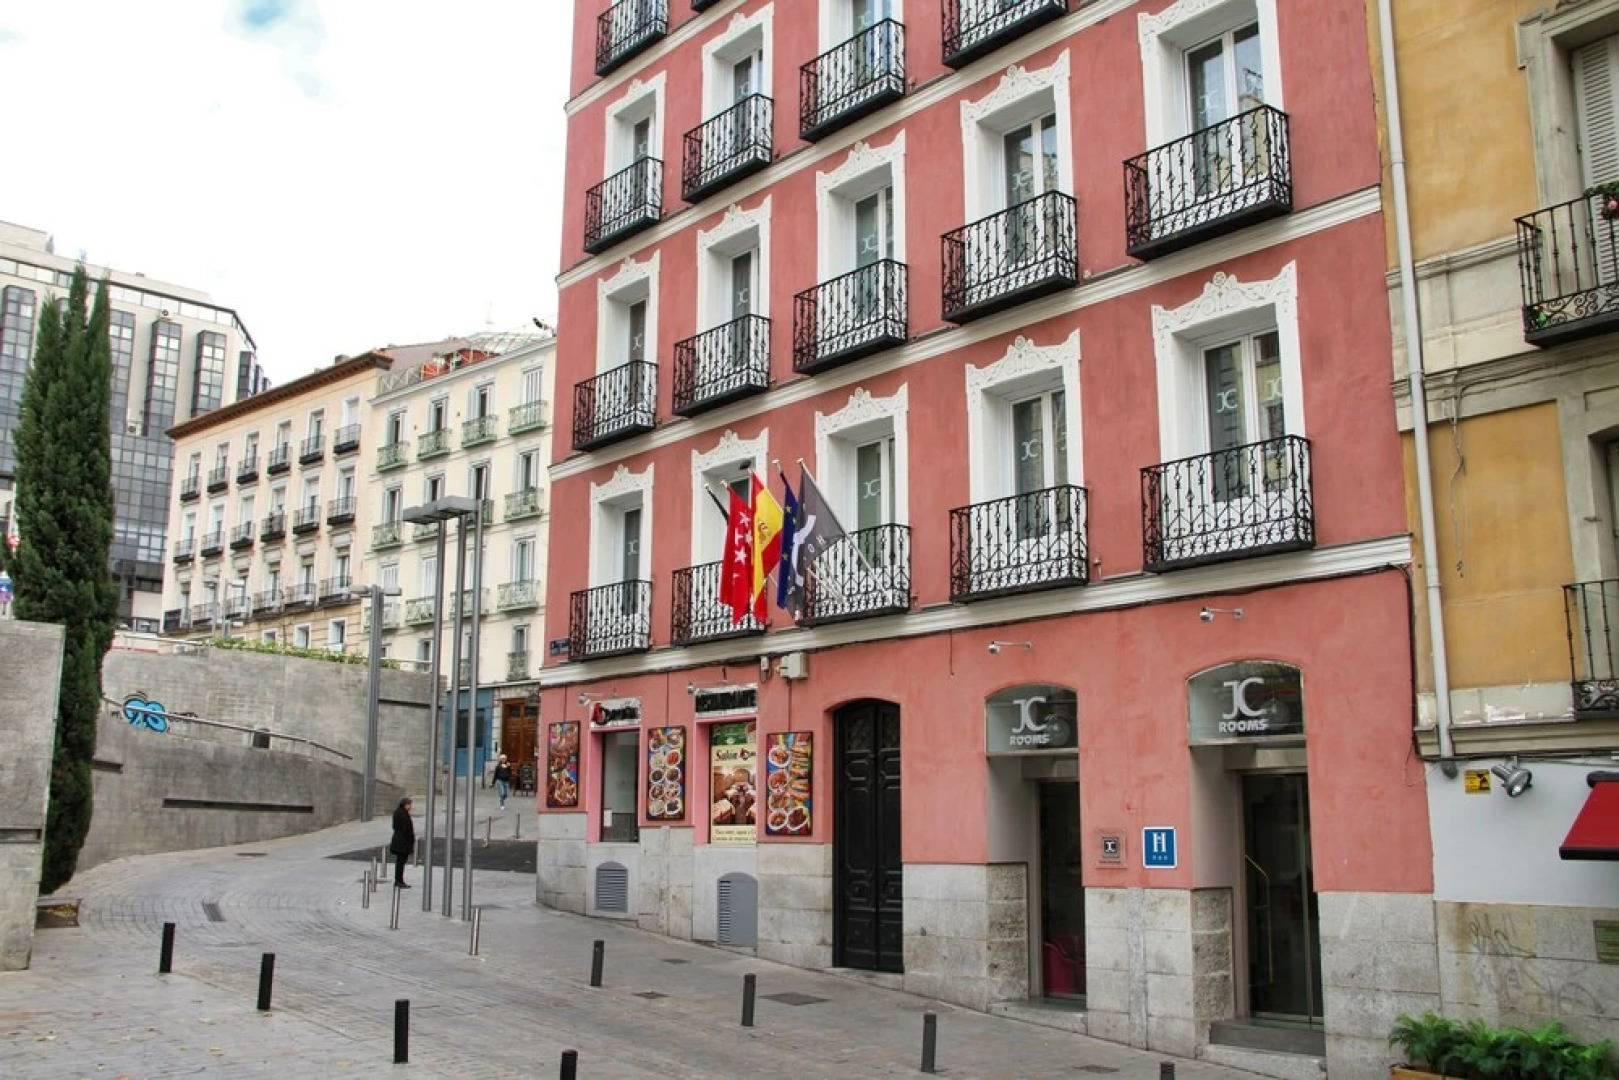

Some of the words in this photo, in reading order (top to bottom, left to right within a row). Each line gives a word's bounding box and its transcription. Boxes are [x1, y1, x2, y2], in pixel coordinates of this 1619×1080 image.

[1216, 388, 1238, 414] JC
[1222, 677, 1266, 719] JC
[1012, 696, 1046, 732] JC
[1219, 719, 1269, 733] ROOMS
[1010, 734, 1050, 746] ROOMS
